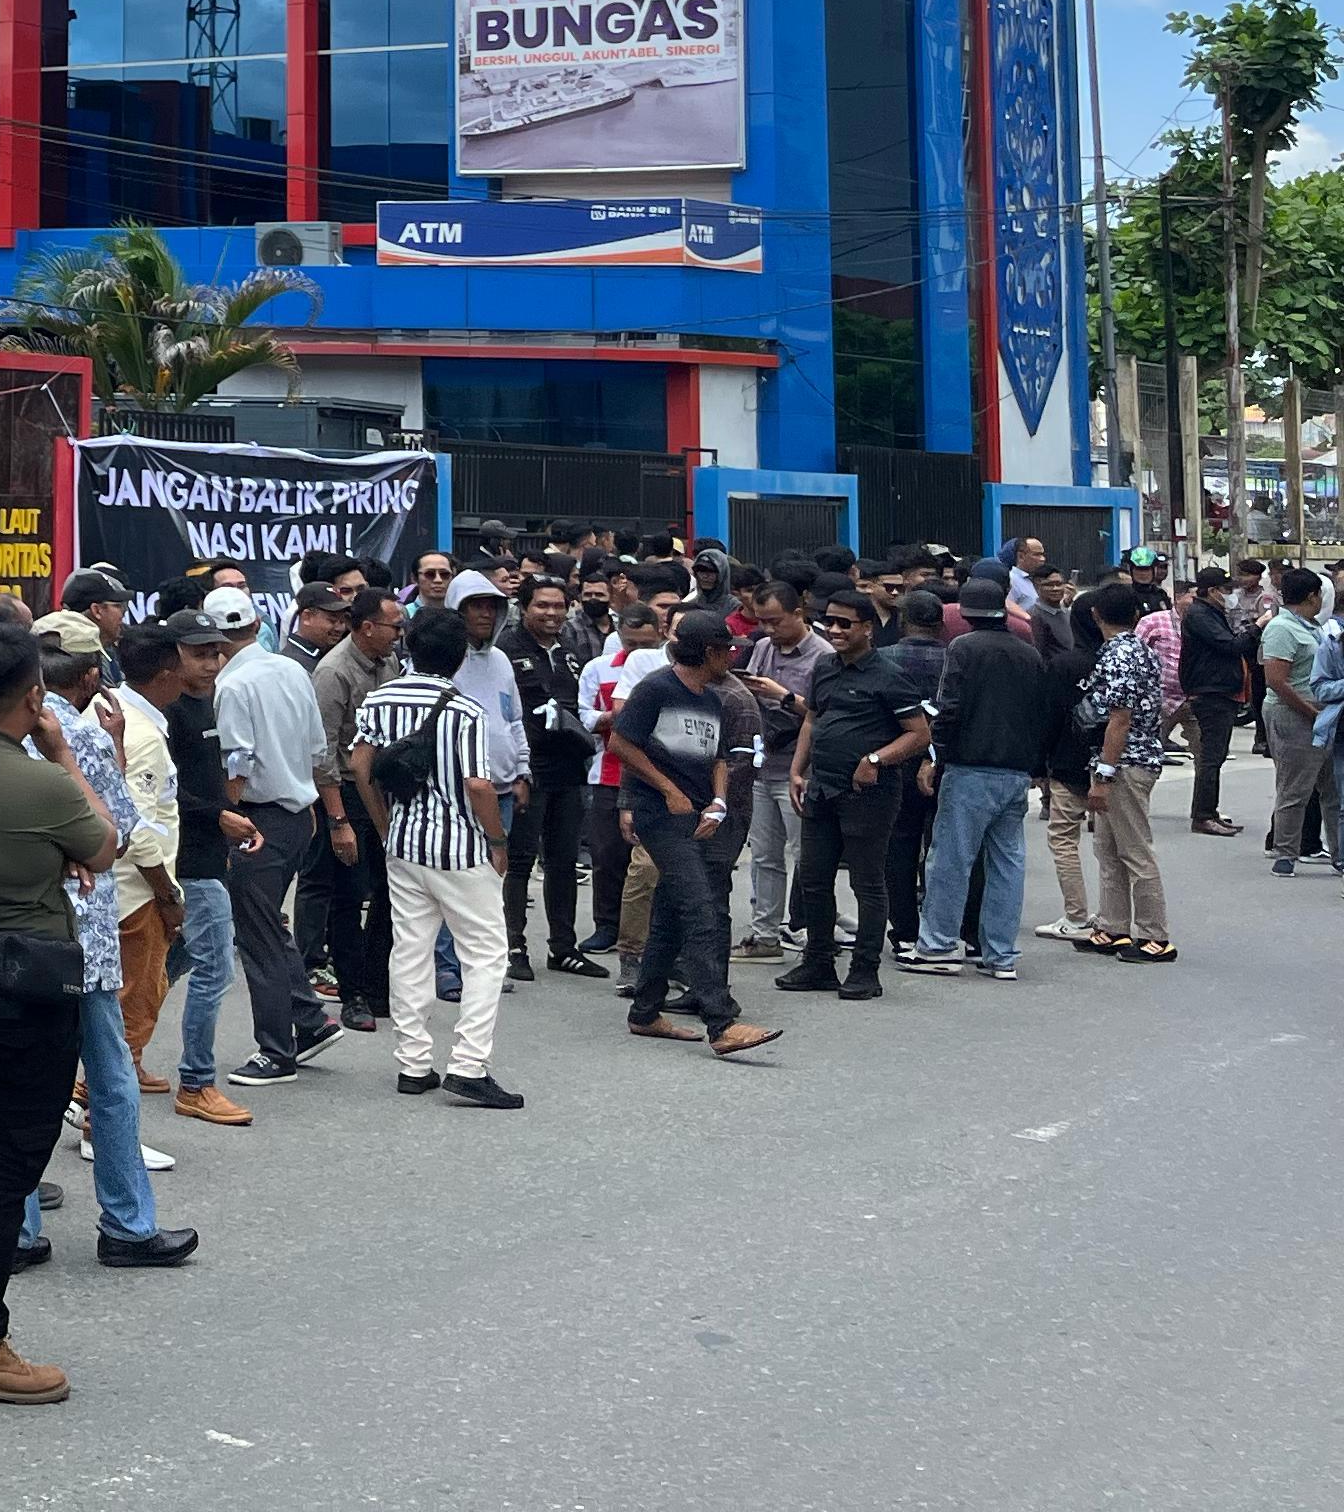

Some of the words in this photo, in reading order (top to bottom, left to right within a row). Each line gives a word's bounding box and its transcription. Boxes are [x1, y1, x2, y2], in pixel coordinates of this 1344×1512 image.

[474, 54, 521, 66] BERSIH,
[582, 47, 662, 61] AKUNTABEL,
[666, 44, 721, 56] SINERGI
[398, 223, 462, 244] ATM
[607, 206, 646, 218] BANK
[688, 223, 714, 245] ATM
[97, 467, 235, 512] JANGAN
[239, 476, 324, 515] BALIK
[330, 477, 420, 514] PIRING
[0, 508, 41, 535] LAUT
[186, 520, 256, 561] NASI
[261, 522, 337, 561] KAMI
